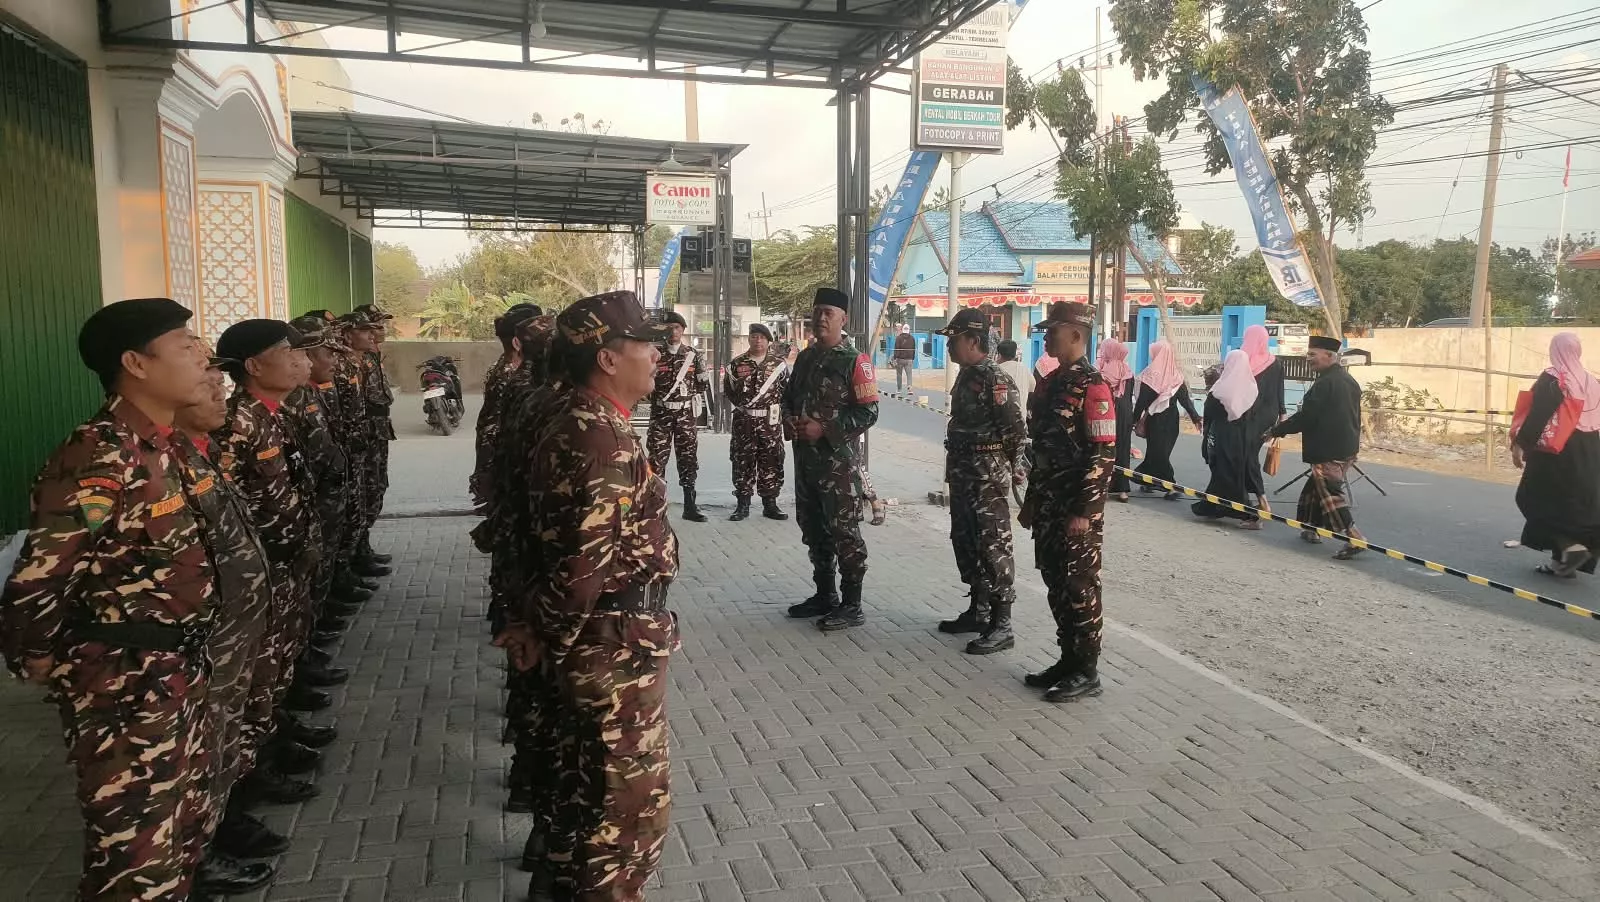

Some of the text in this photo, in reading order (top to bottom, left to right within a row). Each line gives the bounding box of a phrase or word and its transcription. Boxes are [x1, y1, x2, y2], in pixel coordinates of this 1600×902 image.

[932, 87, 994, 101] GERABAH
[925, 108, 945, 119] RENTAL
[925, 128, 1000, 142] FOTOCOPY & PRINT
[653, 182, 710, 197] Canon
